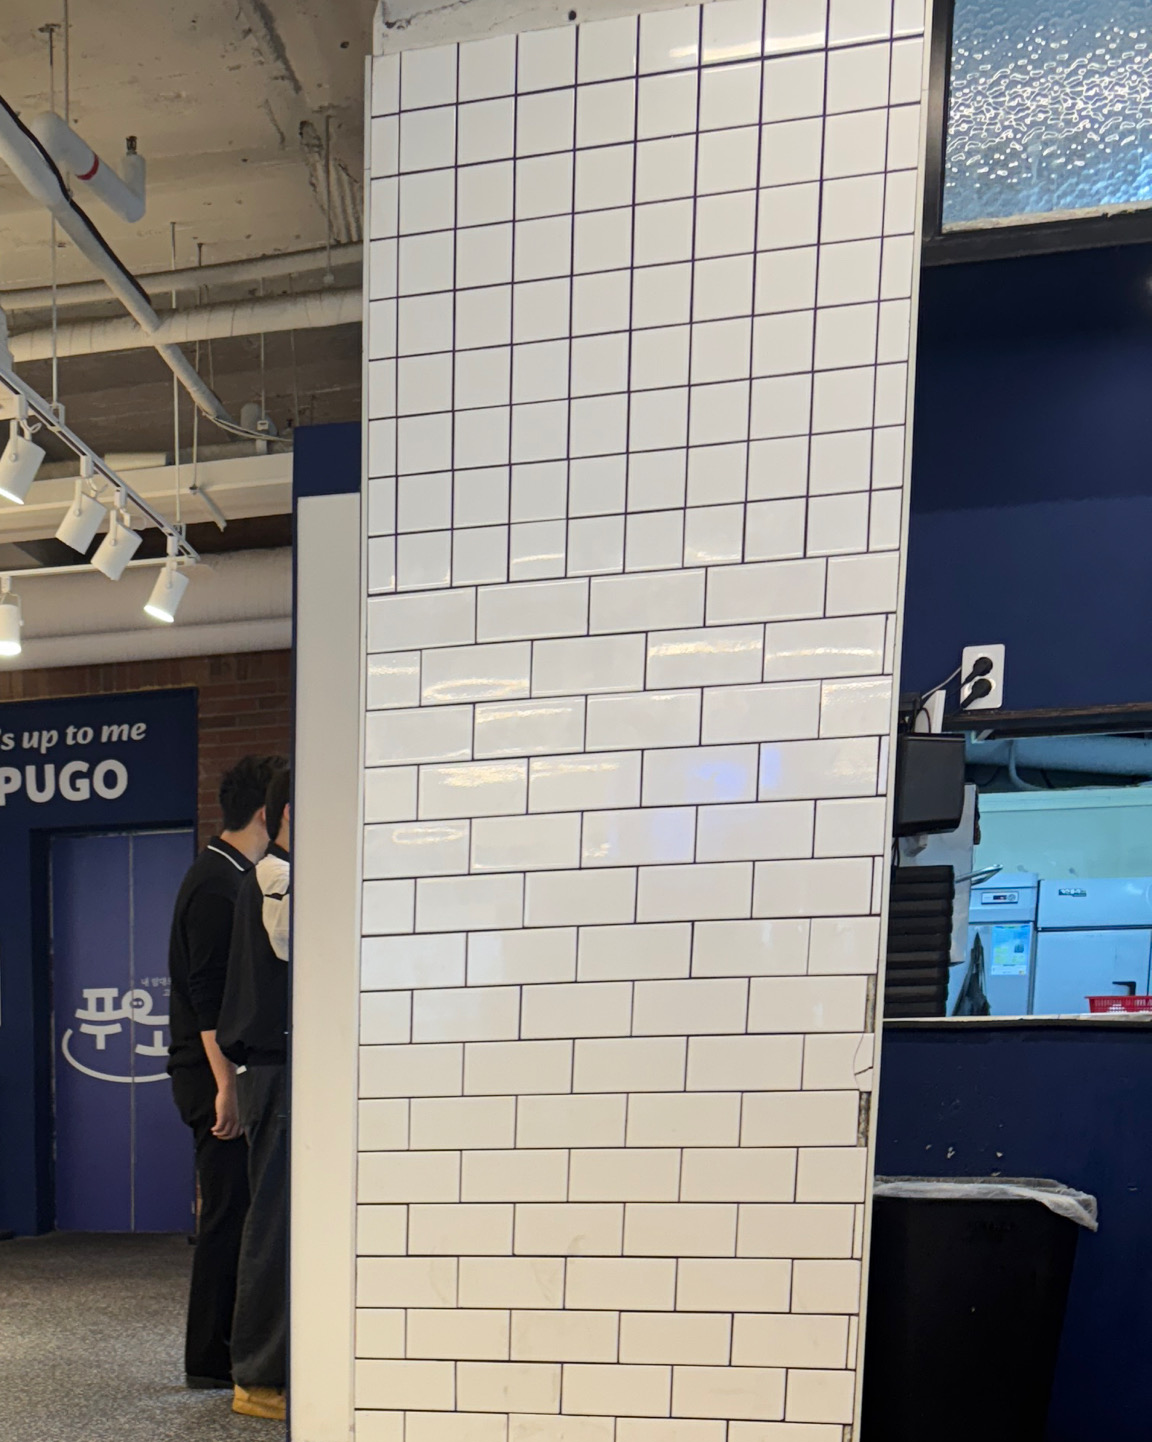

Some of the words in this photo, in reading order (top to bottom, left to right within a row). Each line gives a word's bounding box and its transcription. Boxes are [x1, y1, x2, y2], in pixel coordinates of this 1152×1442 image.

[21, 728, 59, 755] up
[65, 724, 94, 746] to
[100, 721, 147, 744] me
